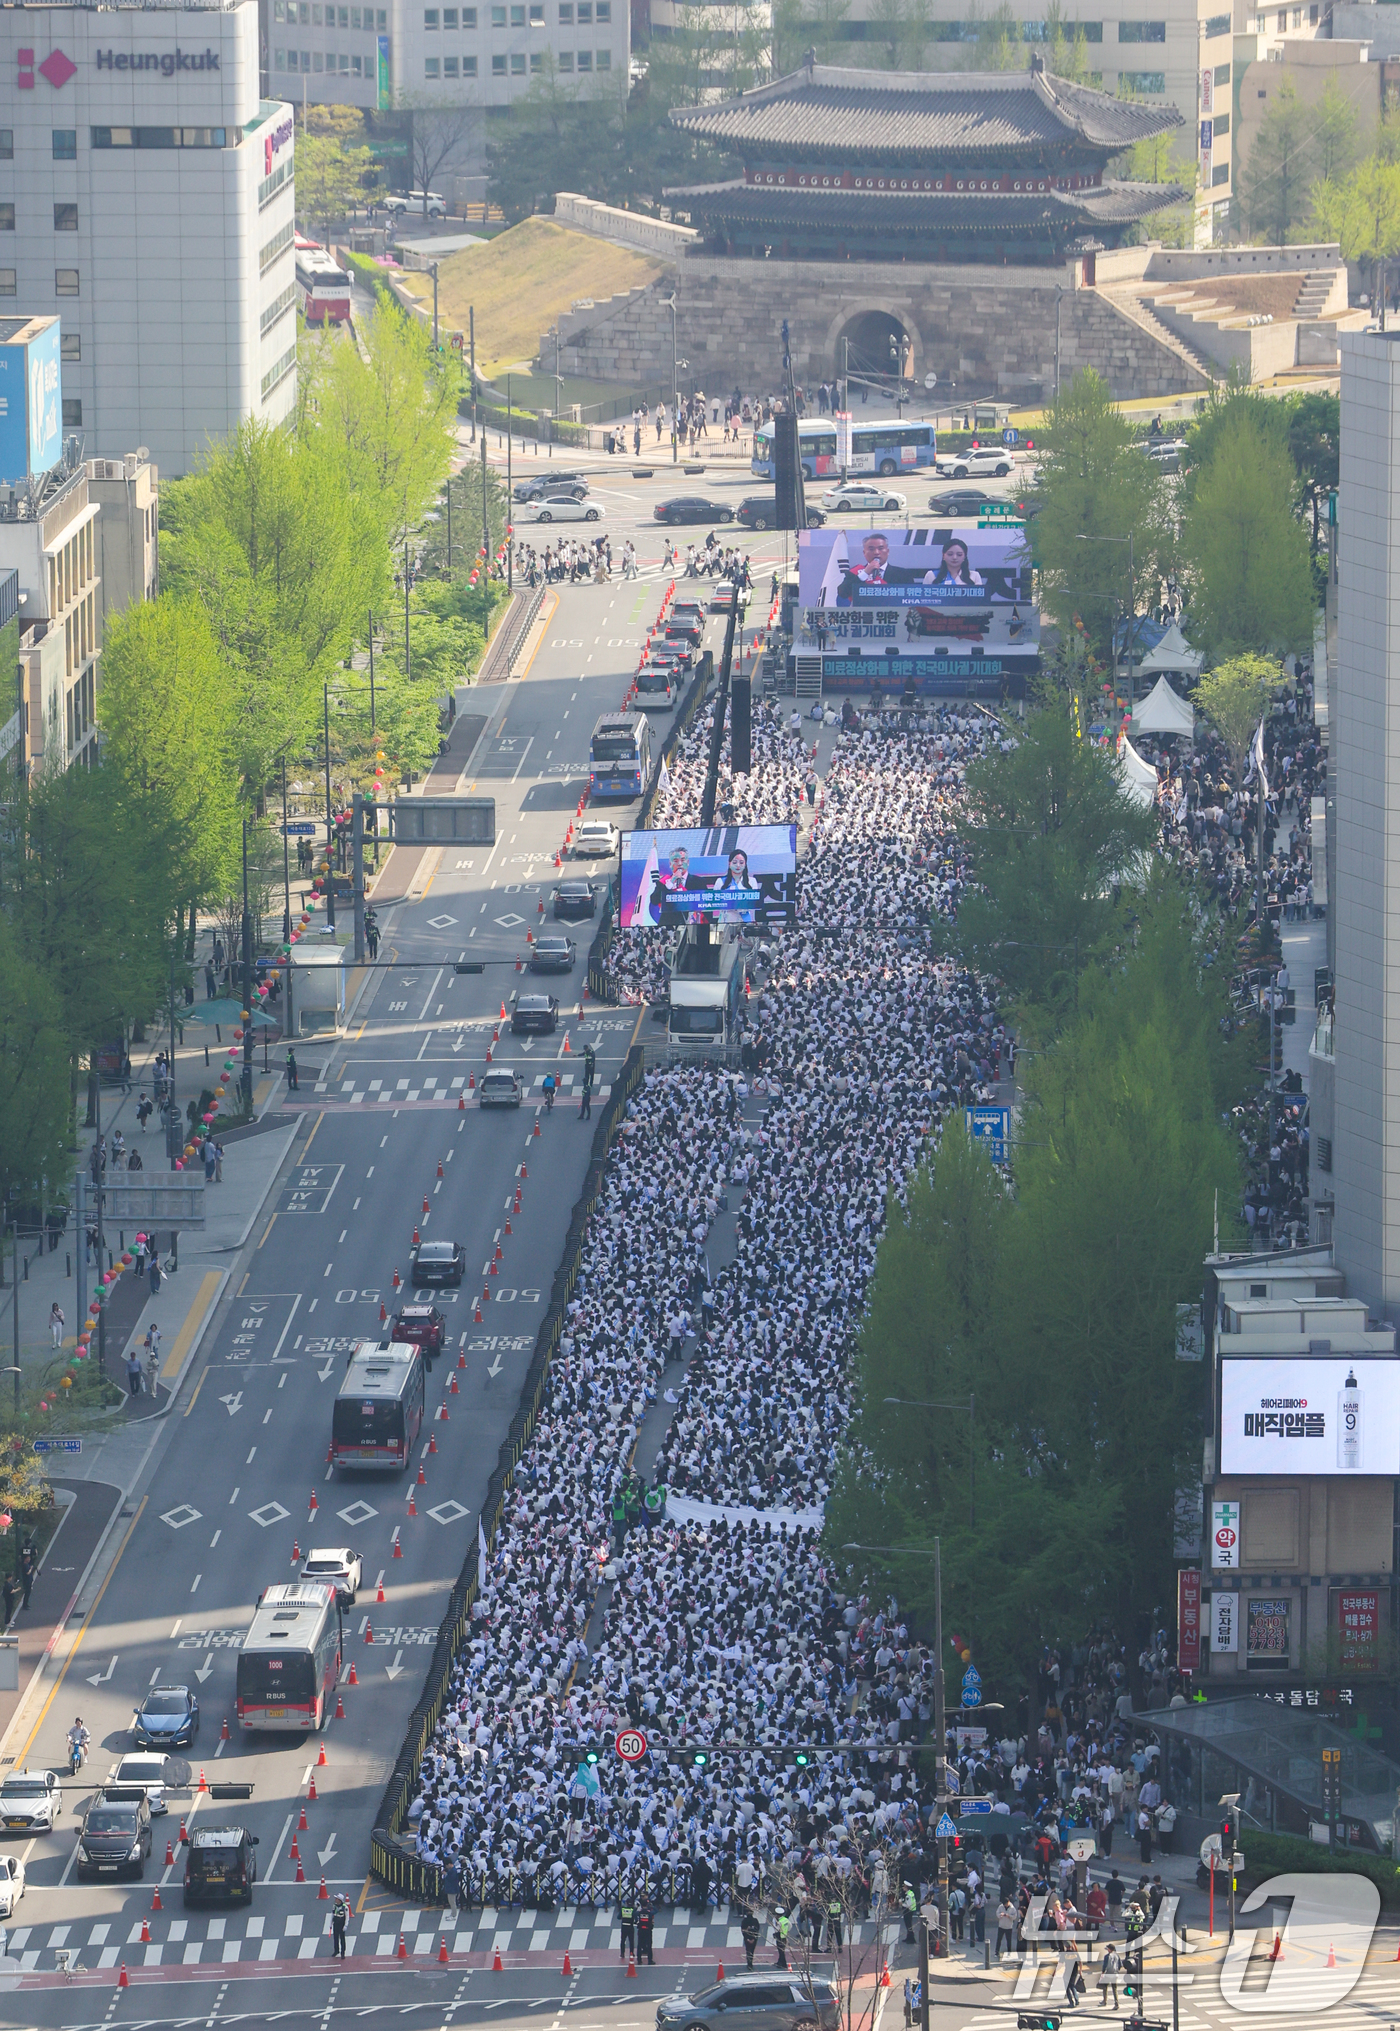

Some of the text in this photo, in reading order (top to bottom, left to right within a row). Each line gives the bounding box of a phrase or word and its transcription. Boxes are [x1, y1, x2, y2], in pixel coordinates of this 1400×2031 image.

[96, 49, 220, 76] Heungkuk
[1203, 70, 1211, 105] Canon
[858, 587, 985, 597] 의료정상화를 위한 전국의사궐기대회
[876, 610, 899, 624] 위한
[850, 625, 896, 638] 궐기대회
[551, 639, 584, 648] 50
[607, 638, 640, 647] 50
[824, 660, 1002, 676] 의료정상화를 위한 전국의사궐기대회
[503, 883, 542, 894] 50
[334, 1288, 382, 1304] 50
[413, 1288, 461, 1303] 50
[494, 1288, 542, 1303] 50
[467, 1335, 535, 1351] 광화문
[1260, 1398, 1308, 1409] 헤어리페어9
[1243, 1413, 1326, 1437] 매직앰플
[1345, 1413, 1356, 1431] 9
[1218, 1530, 1234, 1566] 약국
[1182, 1574, 1199, 1584] 시청
[1249, 1602, 1287, 1615] 부동산
[1342, 1598, 1375, 1610] 전국부동산
[1184, 1589, 1198, 1645] 부동산
[1255, 1617, 1280, 1628] 010
[1218, 1607, 1232, 1645] 전자담배
[1249, 1628, 1285, 1639] 5223
[1249, 1639, 1285, 1650] 7793
[269, 1661, 283, 1669] 1000
[622, 1738, 640, 1754] 50
